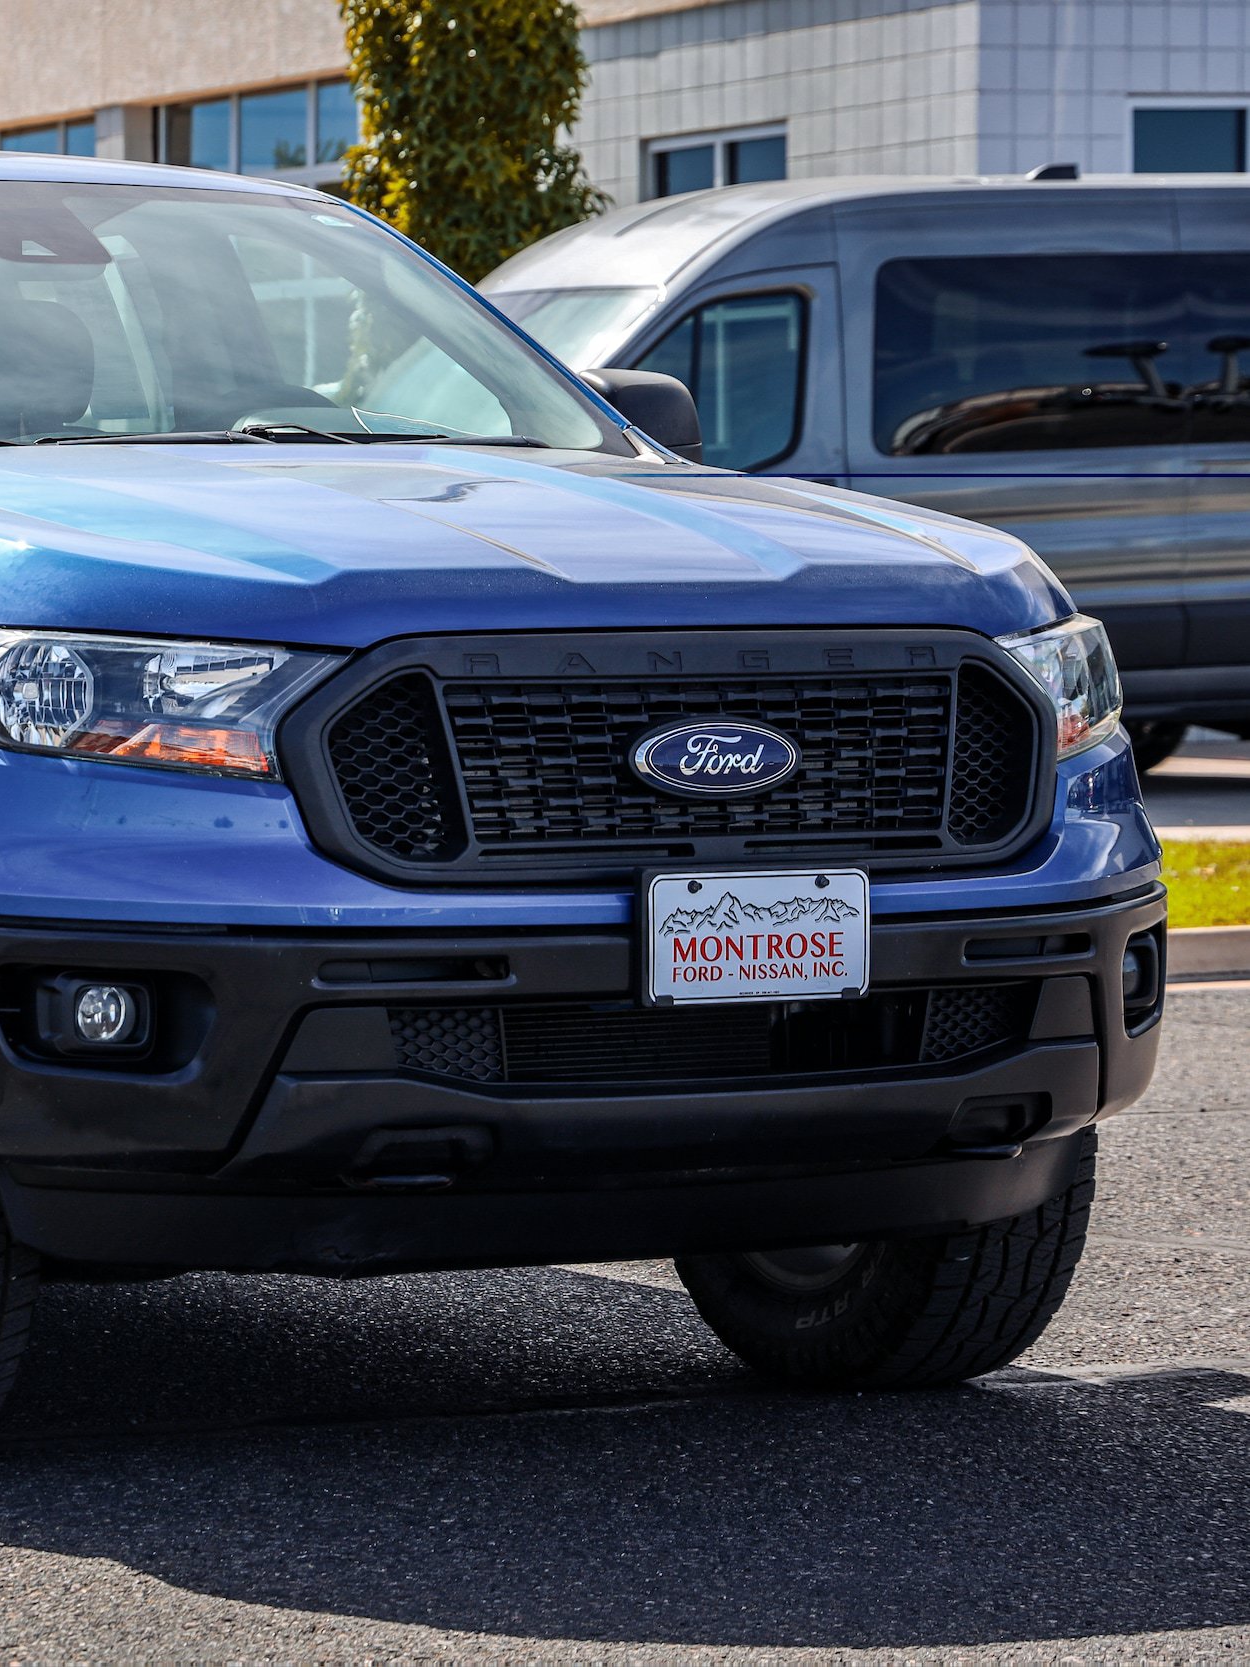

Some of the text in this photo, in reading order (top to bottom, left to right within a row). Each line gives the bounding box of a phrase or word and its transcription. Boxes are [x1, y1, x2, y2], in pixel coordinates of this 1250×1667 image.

[463, 647, 937, 674] RANGER
[679, 733, 765, 775] Ford
[672, 931, 845, 963] MONTROSE
[672, 965, 723, 983] FORD
[739, 963, 808, 981] NISSAN,
[813, 961, 848, 978] INC.
